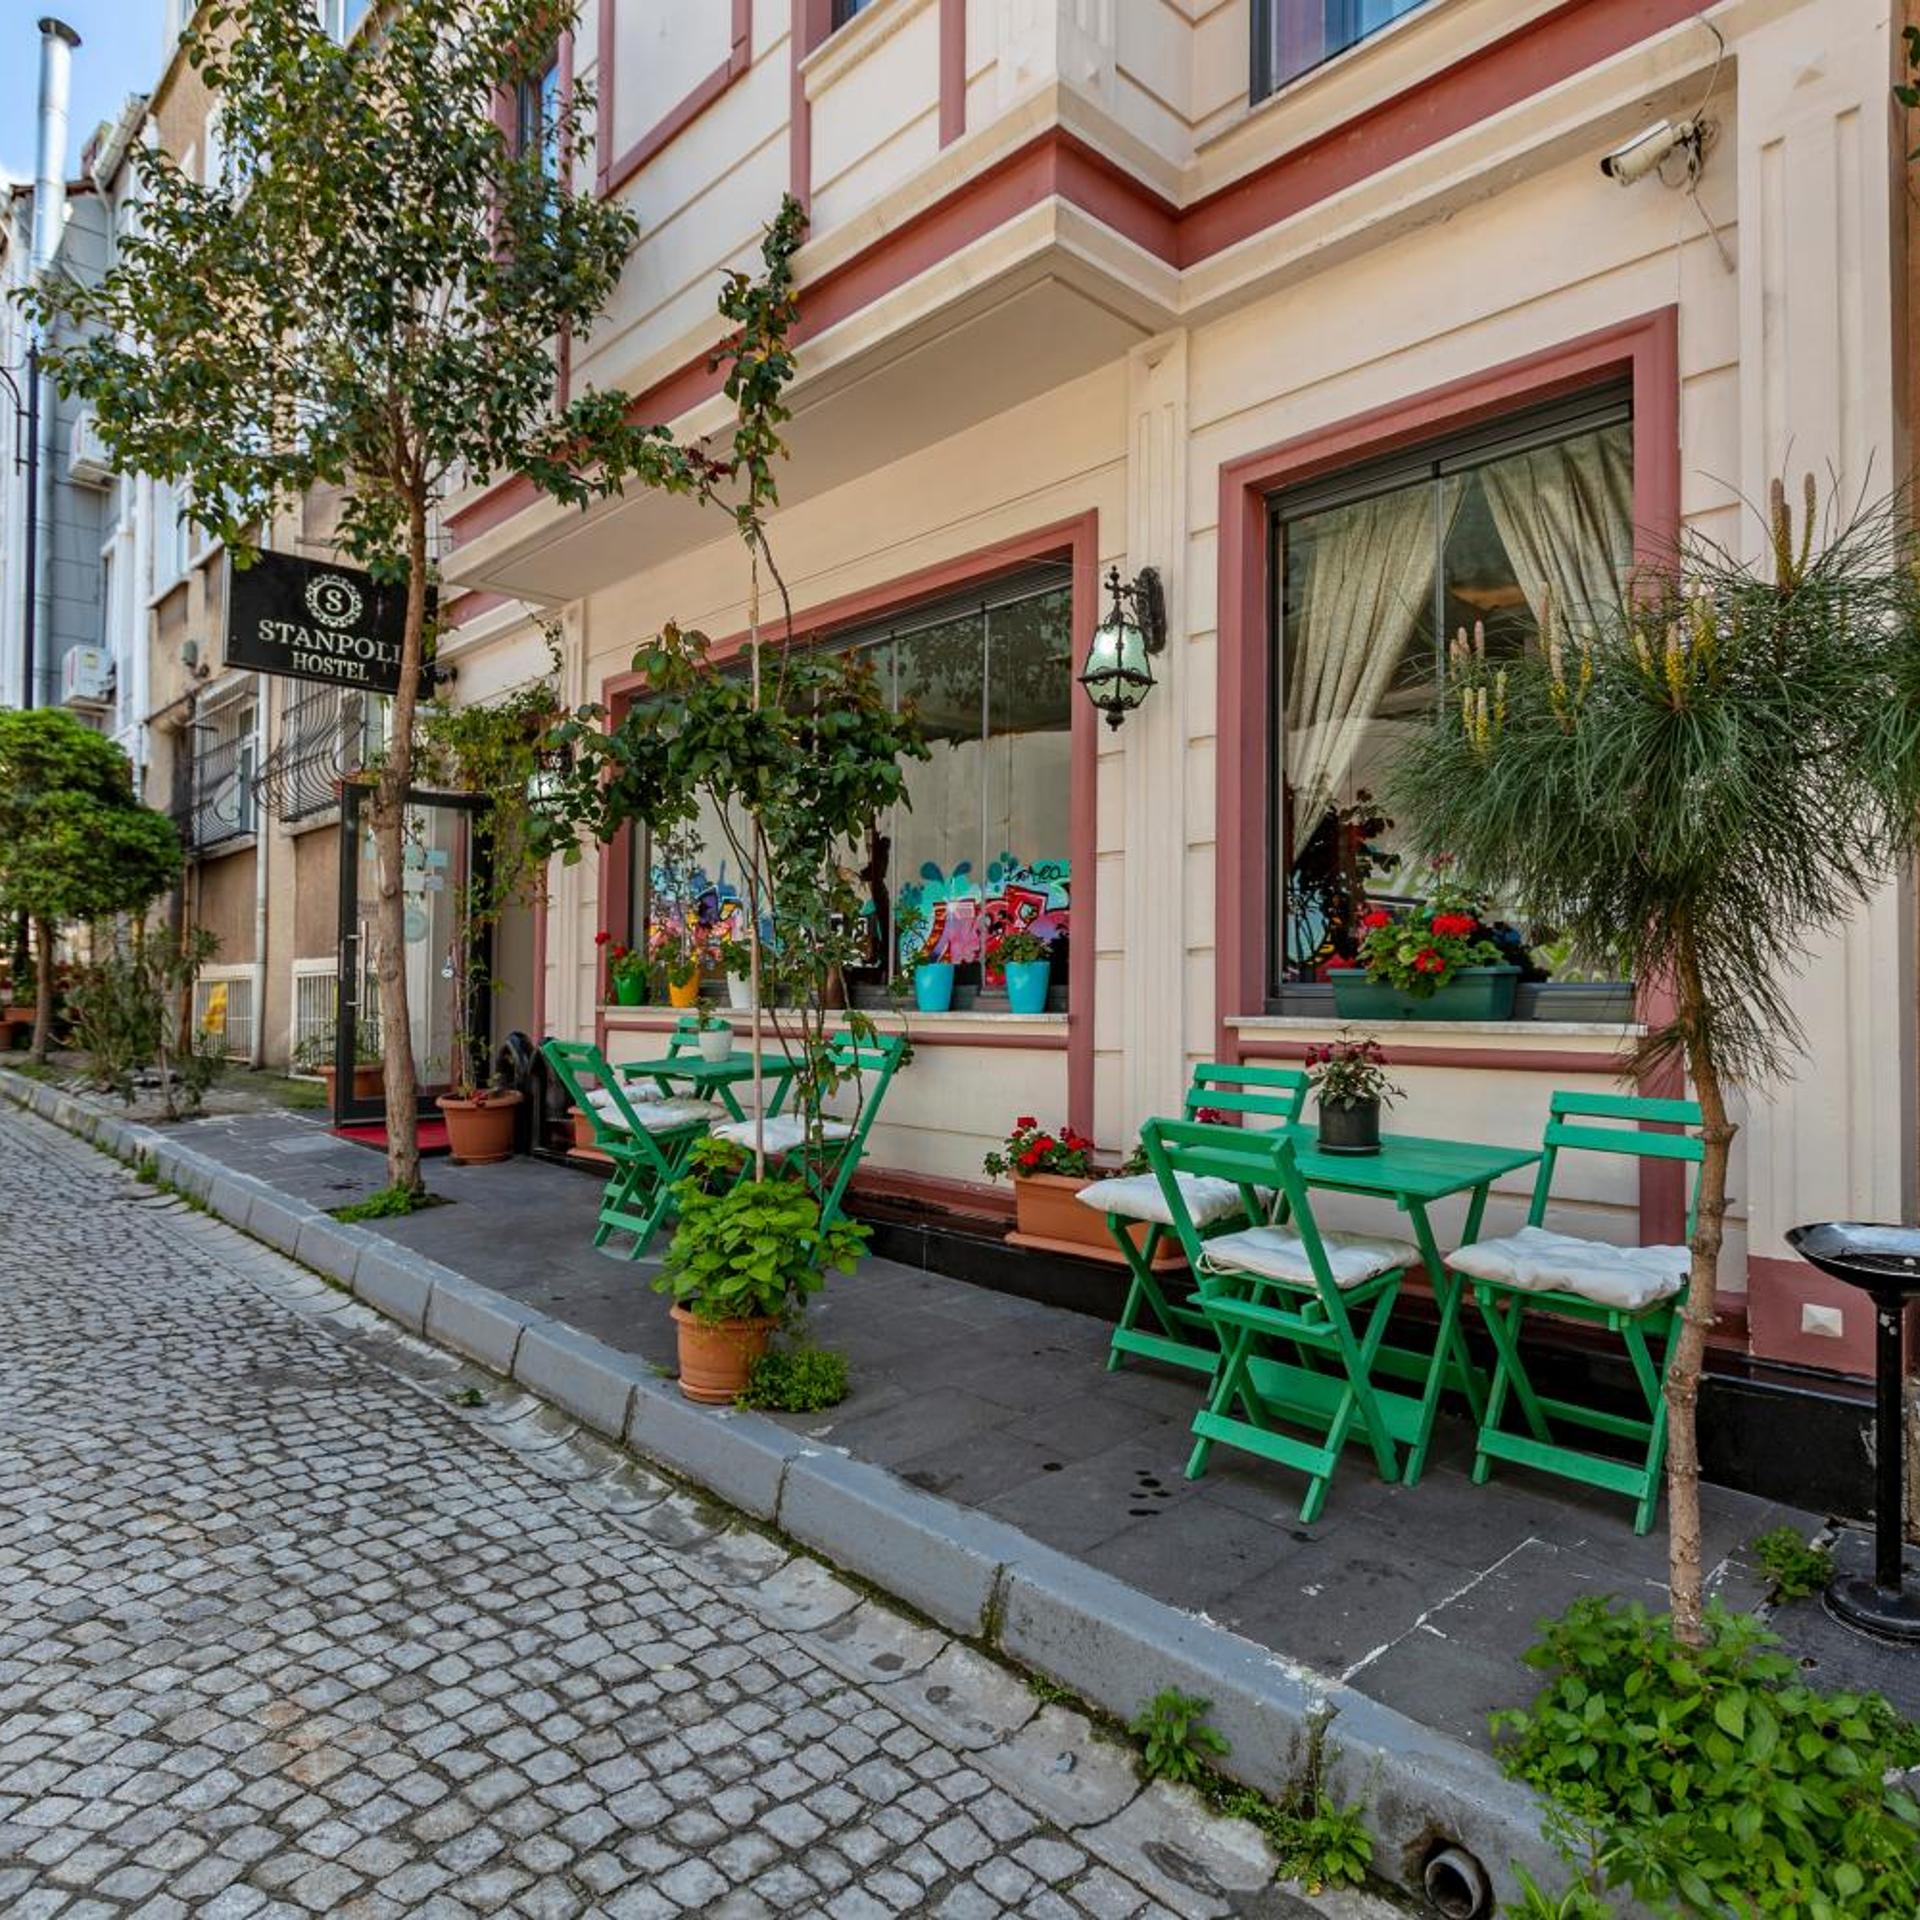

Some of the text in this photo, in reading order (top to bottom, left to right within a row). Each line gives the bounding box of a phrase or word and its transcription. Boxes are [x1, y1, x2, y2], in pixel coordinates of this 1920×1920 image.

[325, 589, 343, 612] S
[258, 618, 401, 664] STANPOLI
[292, 651, 370, 681] HOSTEL
